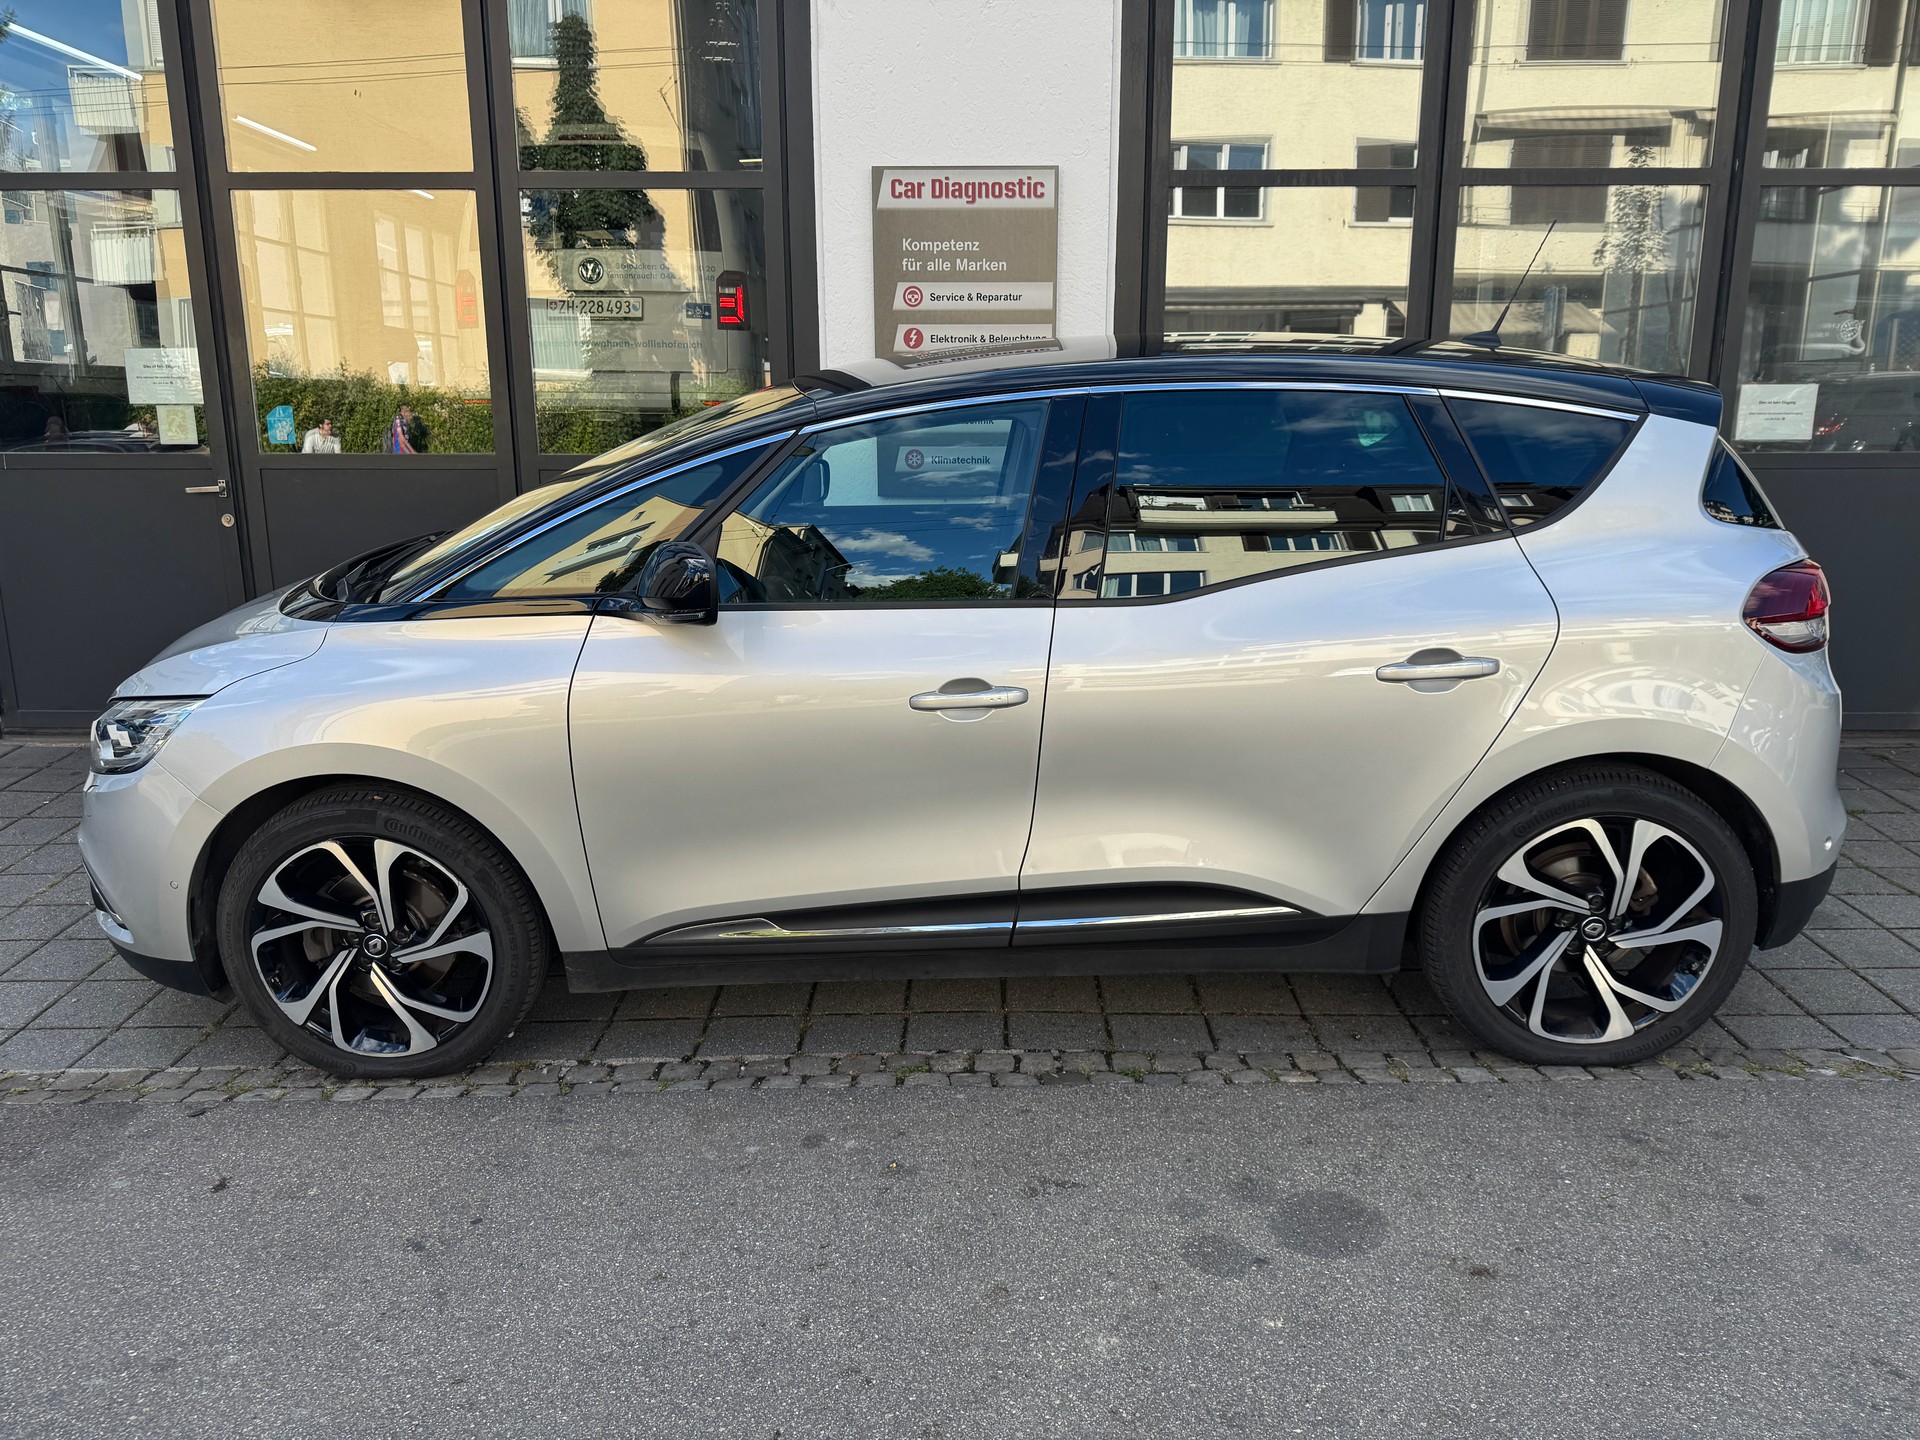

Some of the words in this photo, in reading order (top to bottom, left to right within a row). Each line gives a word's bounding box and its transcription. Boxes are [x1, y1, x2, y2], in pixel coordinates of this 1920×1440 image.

[890, 178, 925, 199] Car
[931, 176, 1045, 205] Diagnostic
[902, 238, 980, 254] Kompetenz
[902, 258, 922, 271] für
[927, 258, 951, 271] alle
[956, 258, 1007, 271] Marken
[929, 292, 965, 302] Service
[967, 292, 974, 302] &
[976, 292, 1023, 304] Reparatur
[930, 334, 977, 344] Elektronik
[979, 334, 987, 344] &
[931, 455, 991, 465] Klimatechnik
[383, 816, 464, 862] Continental
